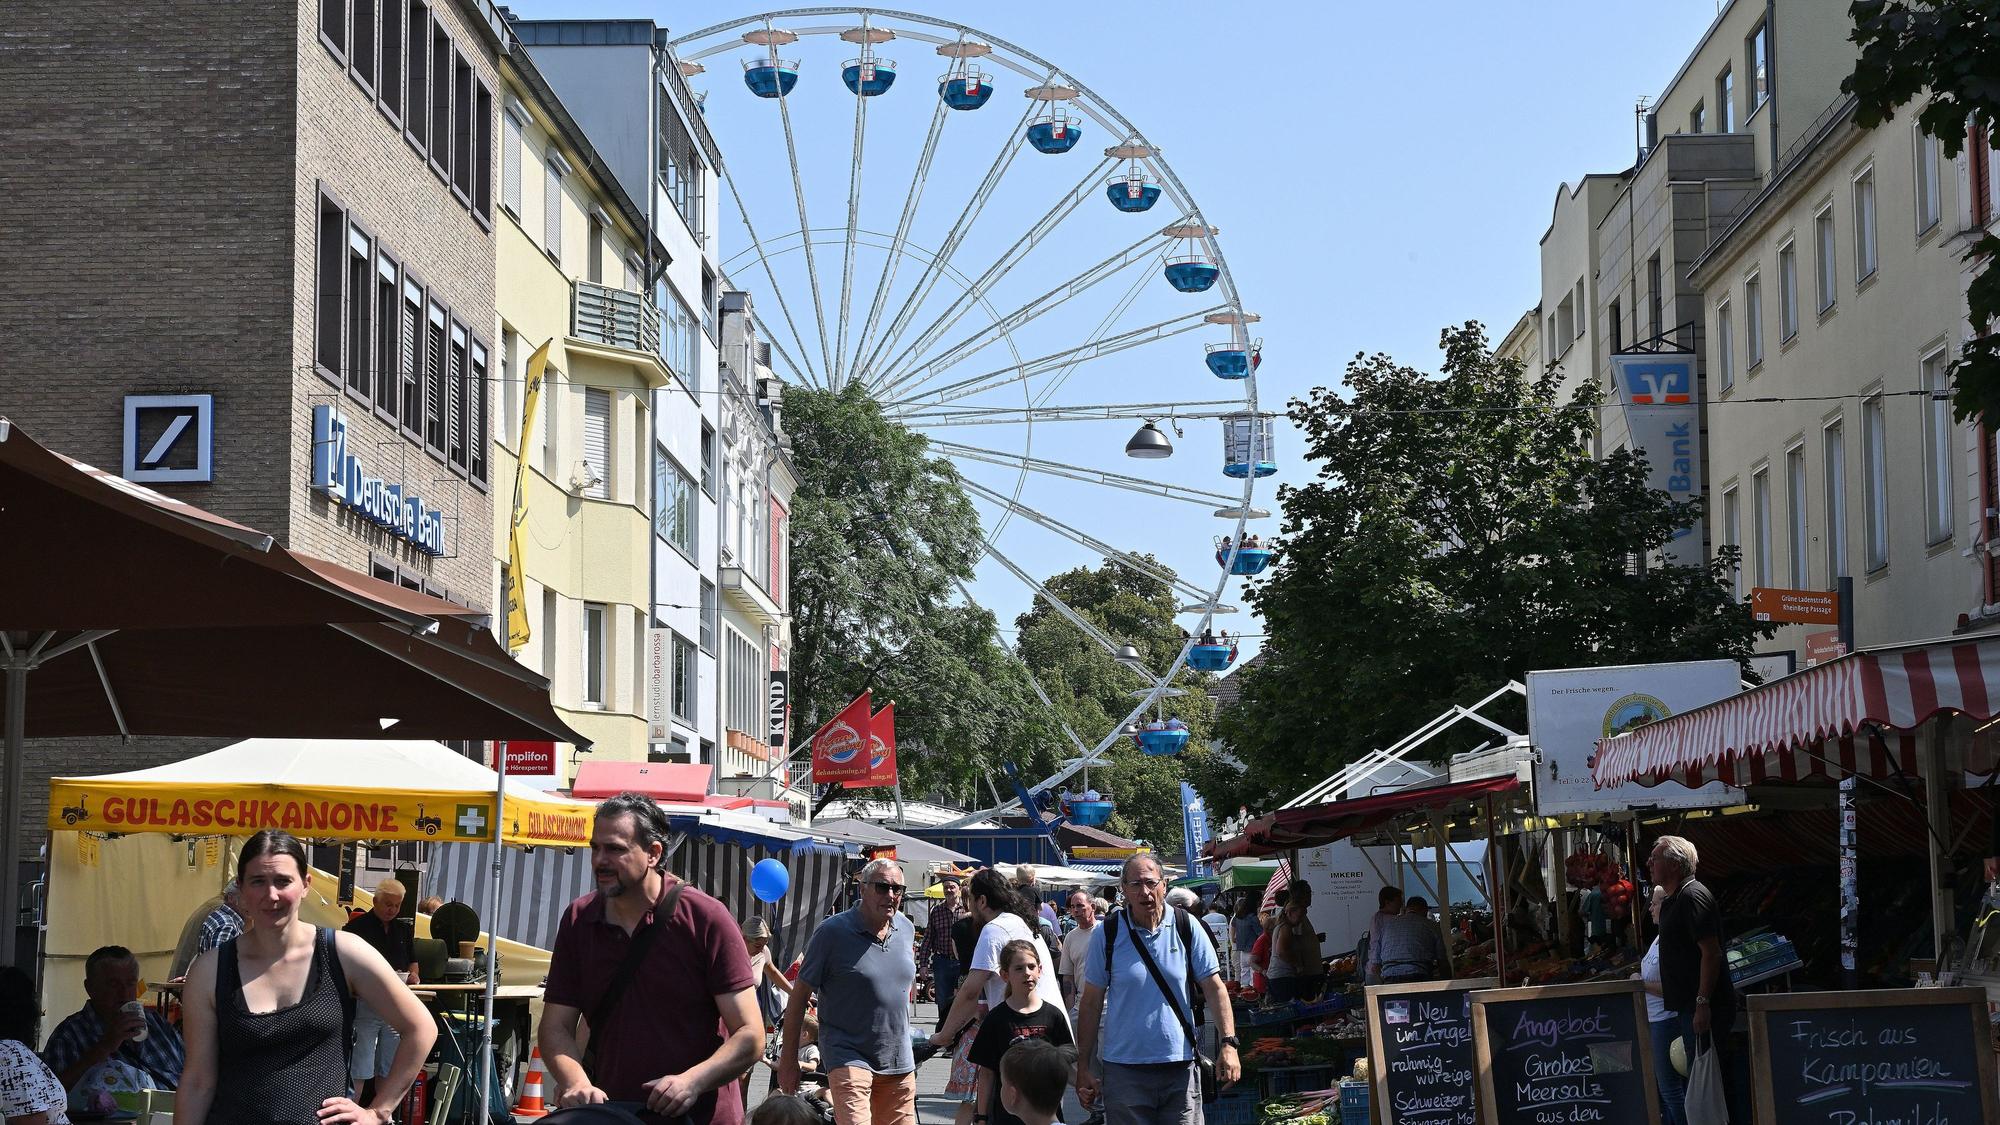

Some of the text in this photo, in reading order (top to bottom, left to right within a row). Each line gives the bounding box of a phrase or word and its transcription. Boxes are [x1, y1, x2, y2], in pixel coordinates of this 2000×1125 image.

[1665, 422, 1691, 492] Bank
[353, 455, 445, 555] Deutsche Bank
[1782, 594, 1832, 605] Grüne Ladenstraße
[1810, 605, 1832, 614] Passage
[652, 633, 661, 721] lernstudiobarbarossa
[1565, 687, 1591, 695] Frische
[770, 681, 784, 734] KIND
[507, 751, 548, 763] mplifon
[102, 797, 399, 832] GULASCHKANONE
[527, 811, 587, 841] GULASCHKANONE
[1418, 1001, 1448, 1021] Neu
[1396, 1028, 1421, 1043] im
[1512, 1006, 1611, 1047] Angebot
[1789, 1018, 1918, 1049] Frisch aus
[1525, 1051, 1593, 1077] Grobes
[1801, 1055, 1952, 1096] Kampanien
[1416, 1068, 1472, 1087] würzige
[1516, 1075, 1605, 1102] Meersalz
[1394, 1090, 1466, 1110] Schweizer
[1828, 1101, 1949, 1125] Rhlch
[1536, 1104, 1605, 1123] aus den
